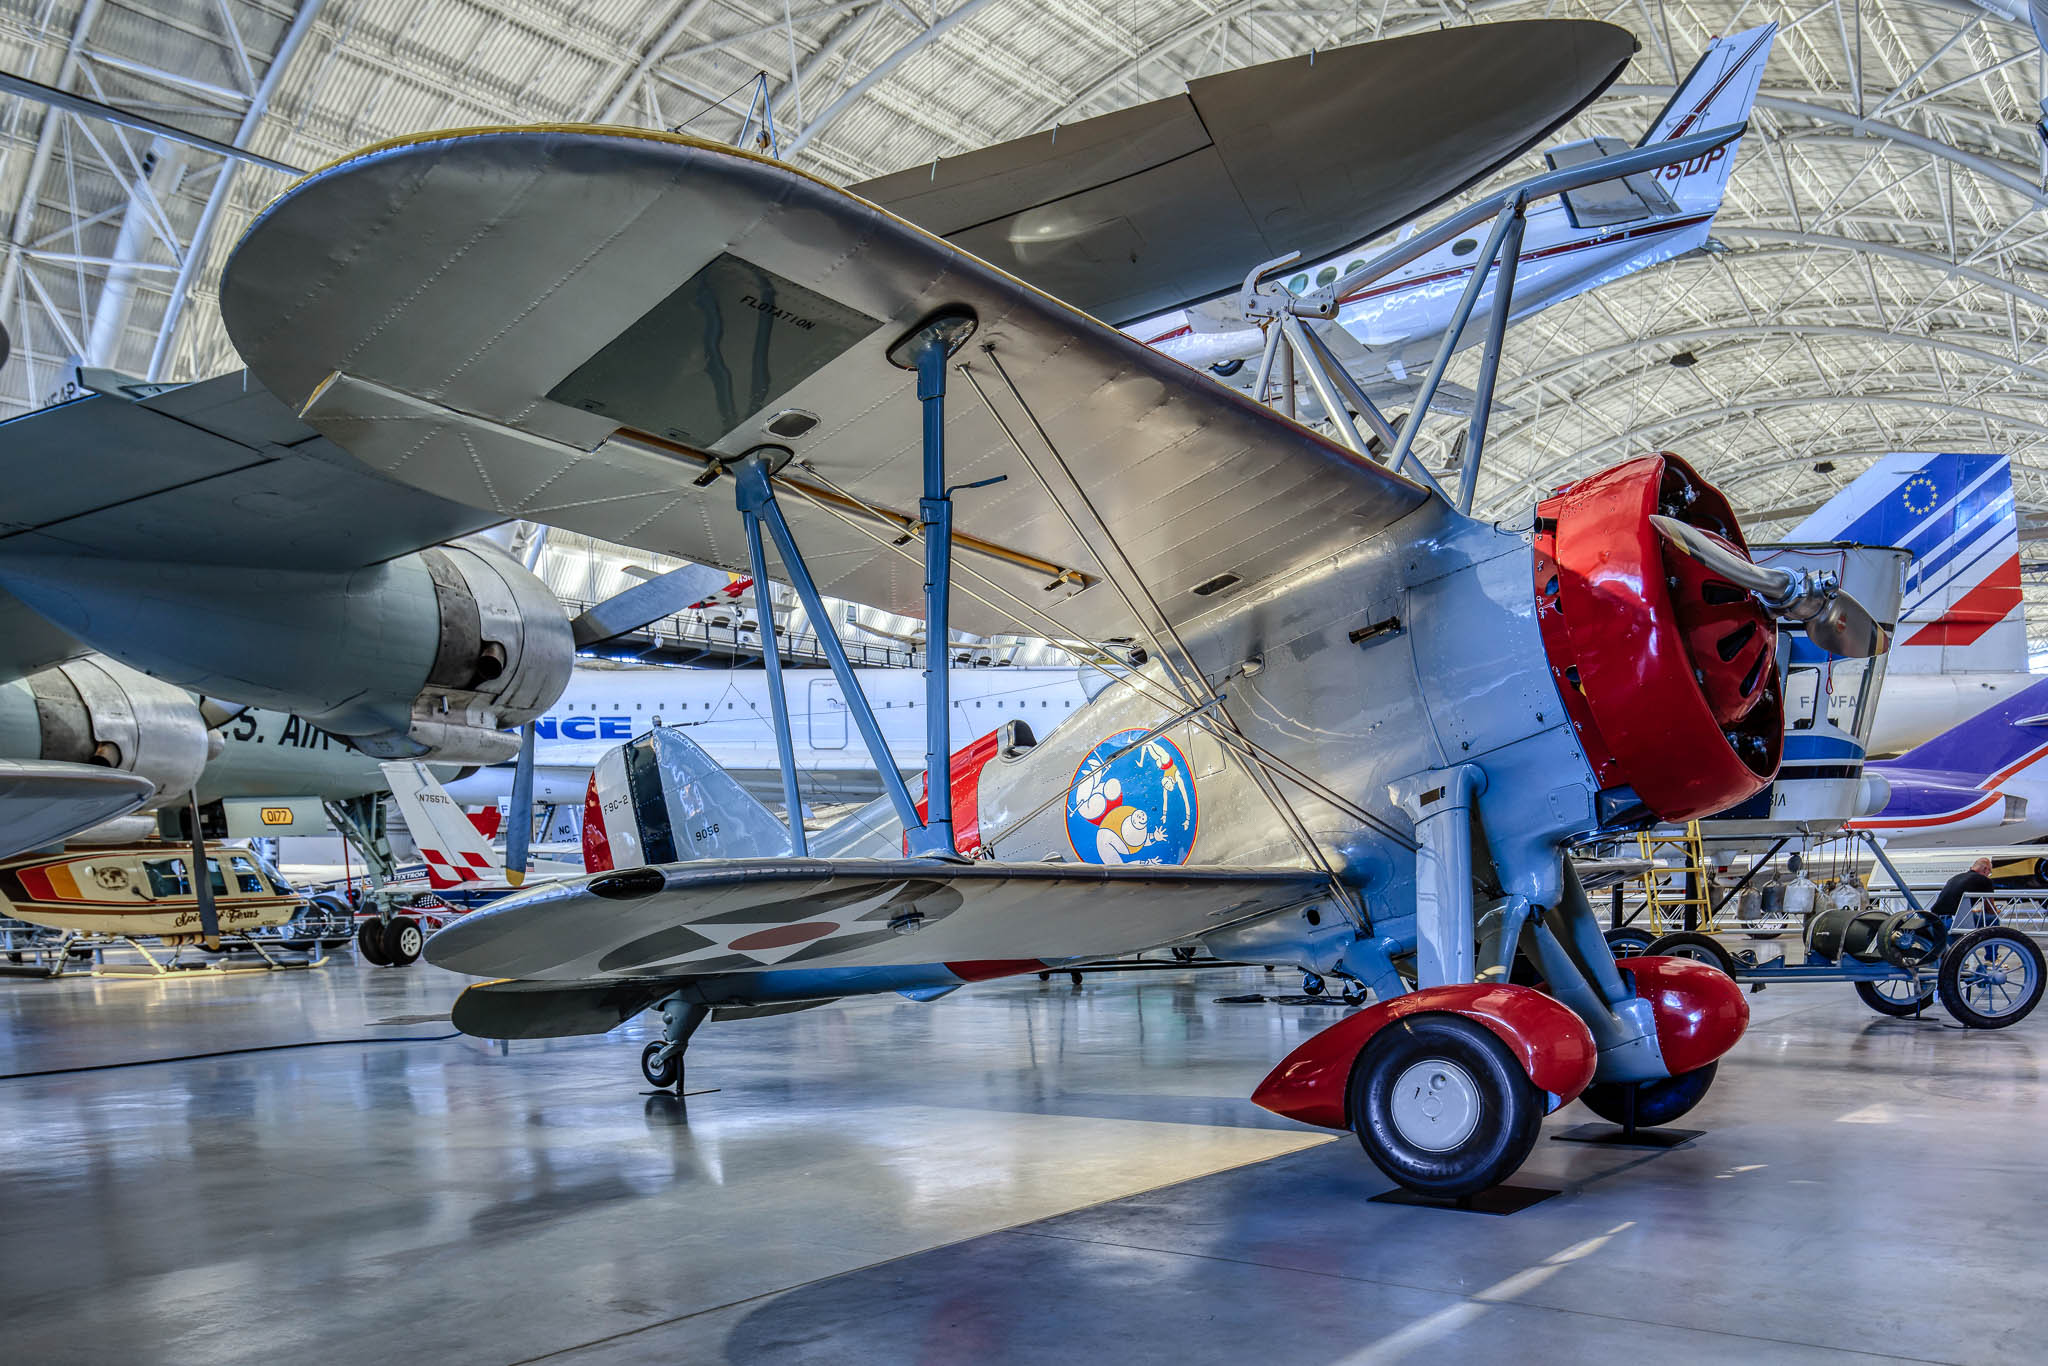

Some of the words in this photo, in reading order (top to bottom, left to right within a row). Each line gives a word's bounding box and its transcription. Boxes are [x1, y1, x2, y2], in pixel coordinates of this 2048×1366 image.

[740, 295, 817, 330] FLOTATION
[518, 716, 633, 740] NCE
[603, 794, 630, 815] F9C-2
[695, 823, 720, 842] 9056
